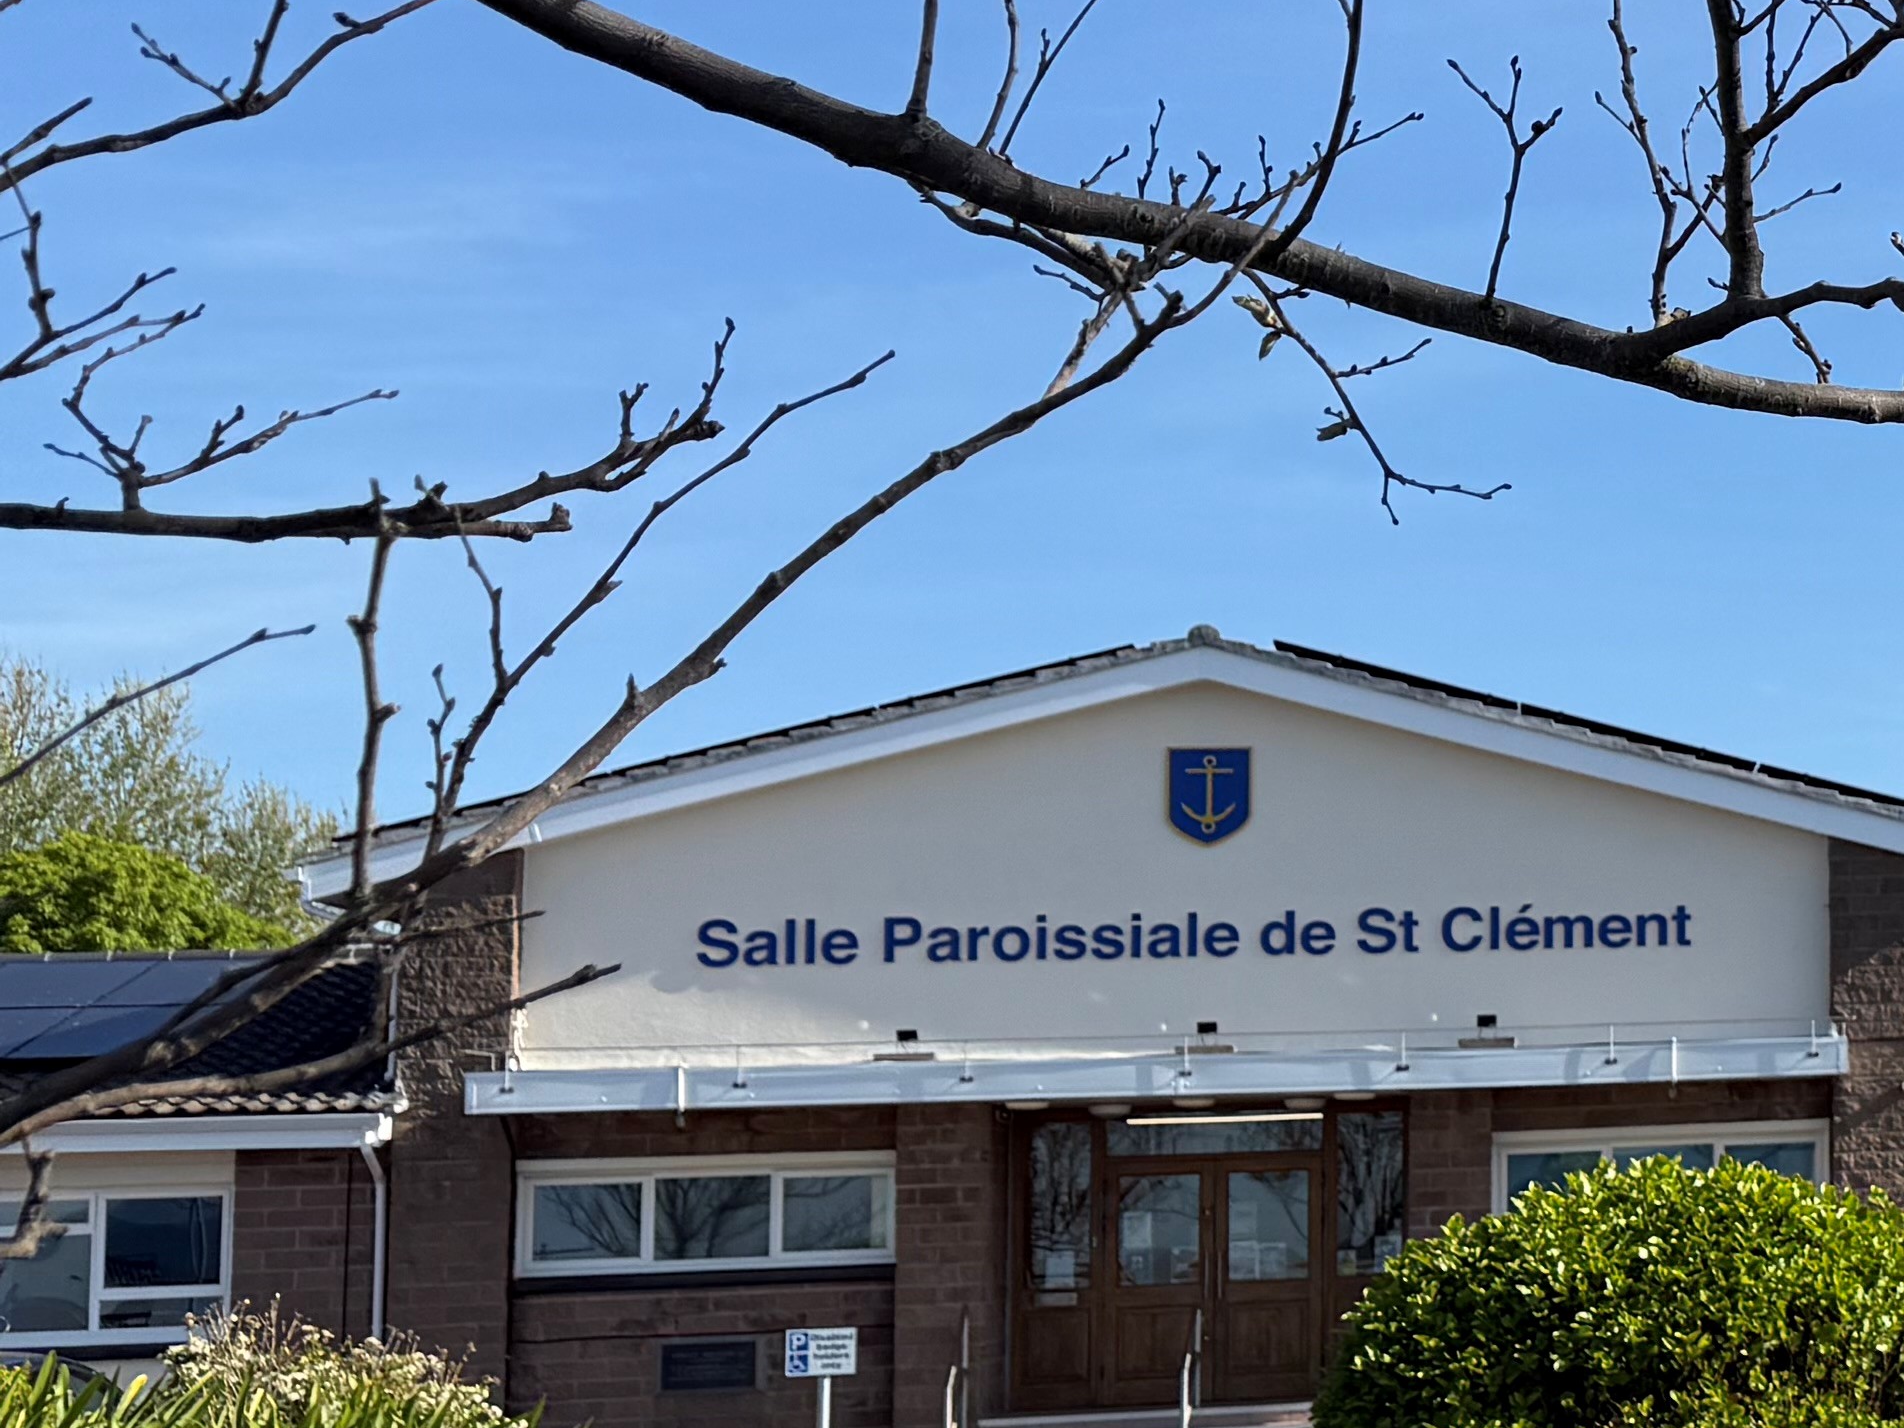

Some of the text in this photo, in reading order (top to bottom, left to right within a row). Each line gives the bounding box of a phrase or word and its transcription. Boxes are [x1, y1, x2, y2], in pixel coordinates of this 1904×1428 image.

[697, 903, 1692, 970] Salle Paroissiale de St Clément
[790, 1334, 807, 1351] P
